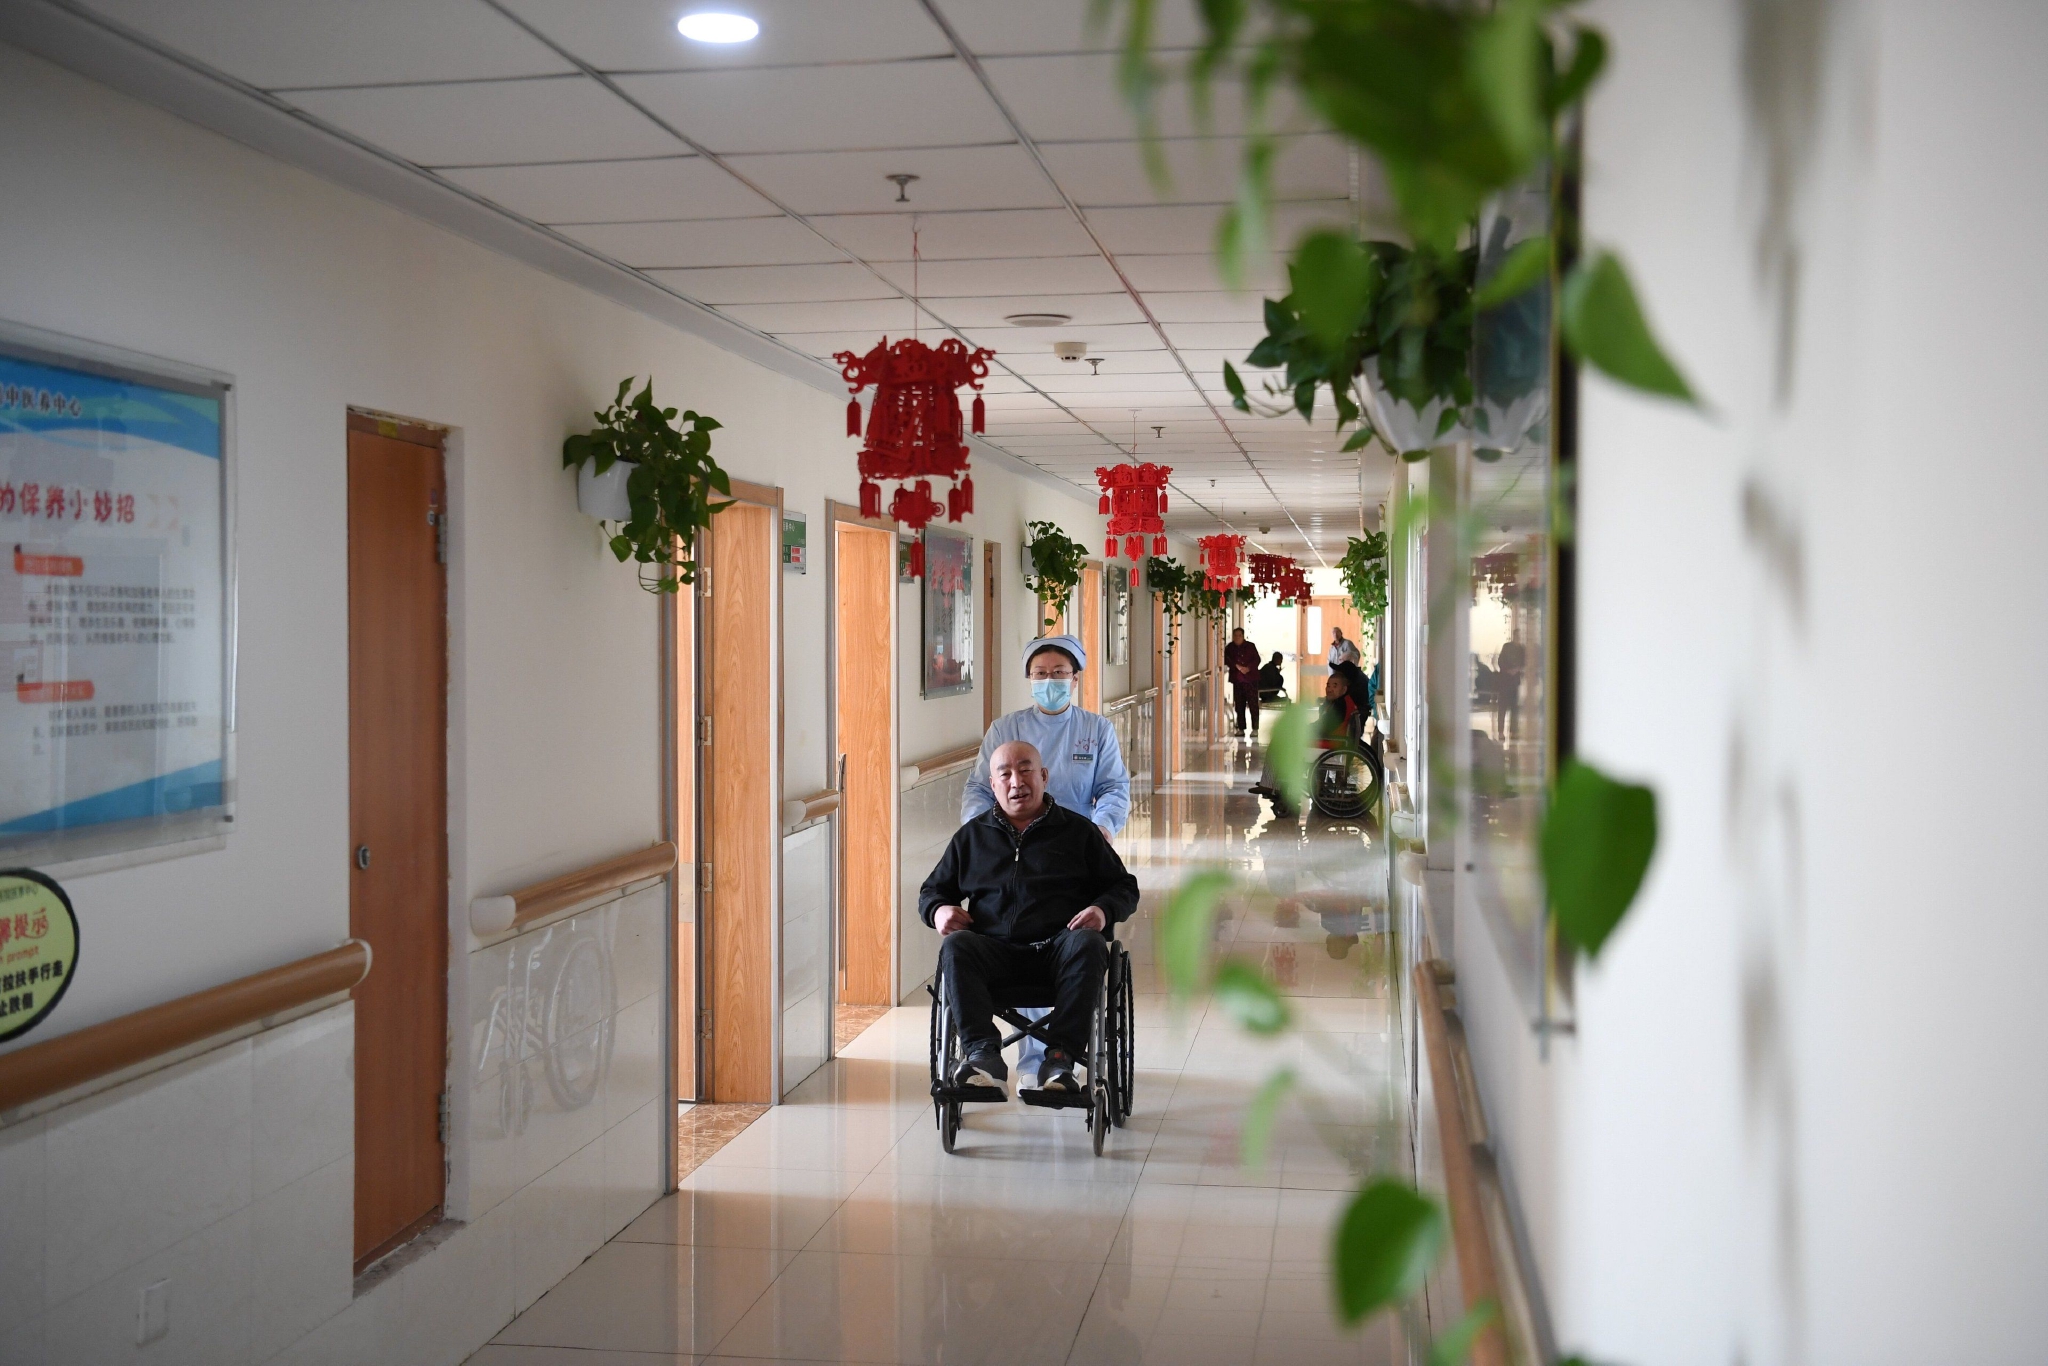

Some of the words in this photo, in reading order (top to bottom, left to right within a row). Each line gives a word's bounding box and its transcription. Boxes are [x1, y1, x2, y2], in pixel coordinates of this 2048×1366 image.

[0, 960, 63, 992] 拉扶手行走
